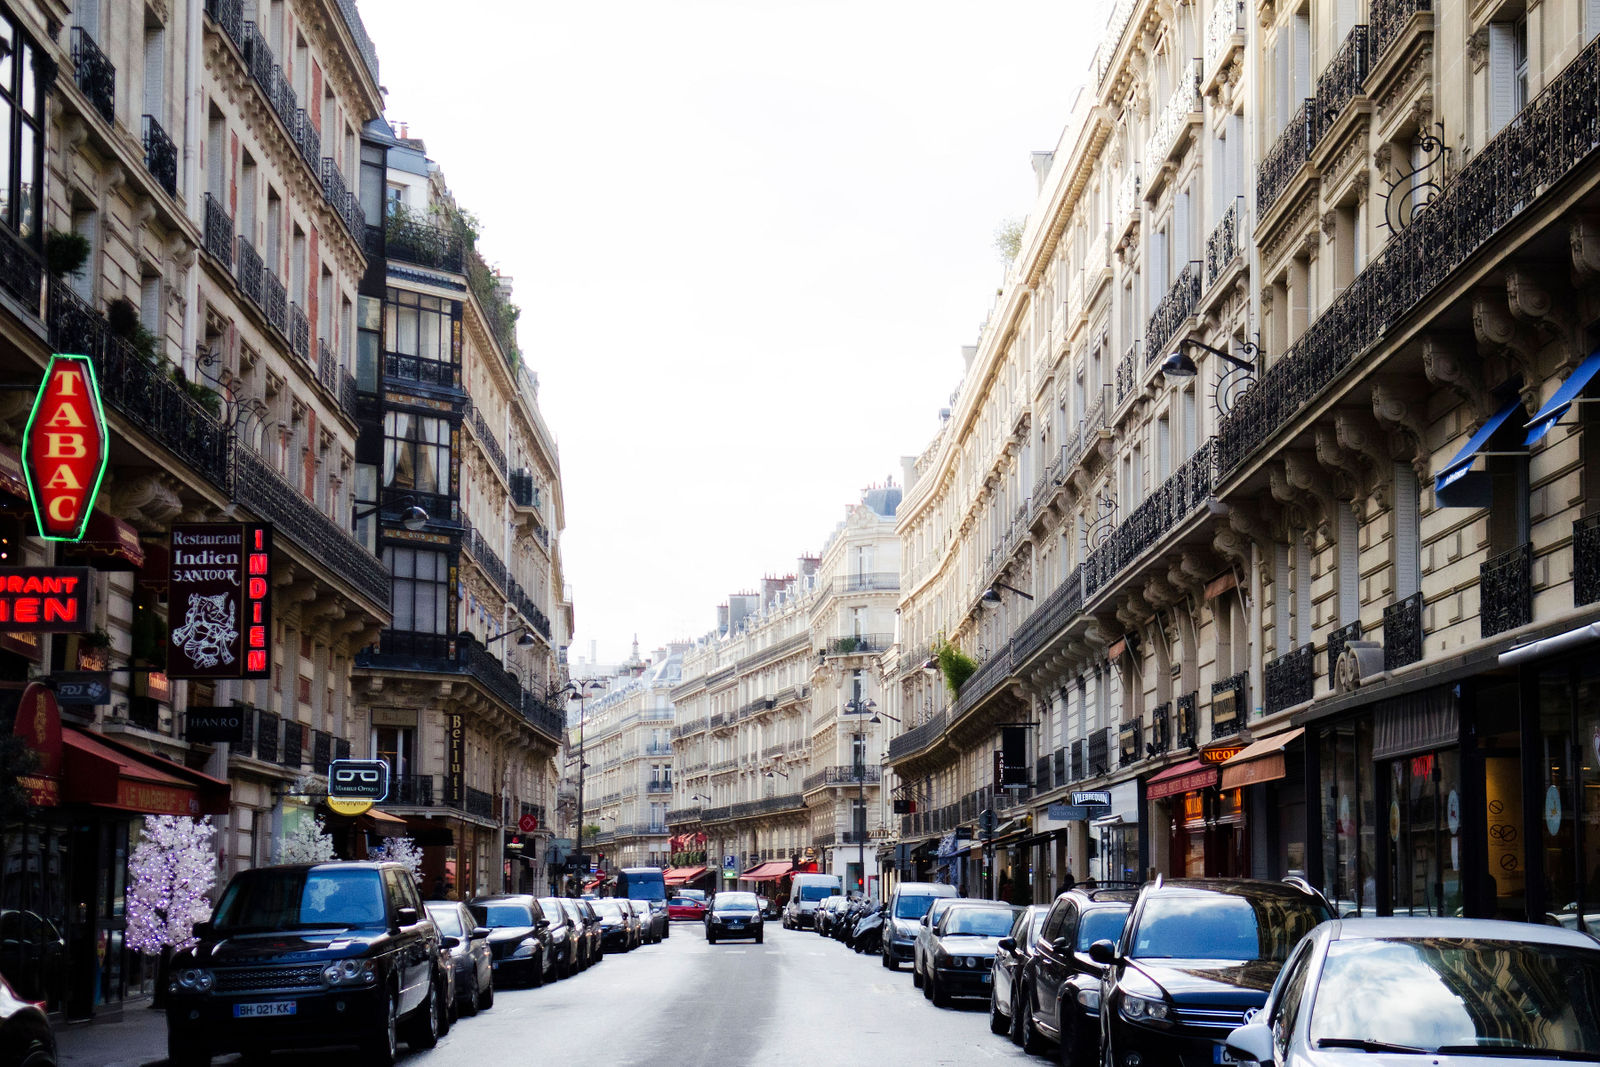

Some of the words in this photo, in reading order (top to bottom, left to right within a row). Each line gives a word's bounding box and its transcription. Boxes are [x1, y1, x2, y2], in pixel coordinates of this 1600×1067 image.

[43, 370, 87, 522] TABAC
[172, 530, 241, 545] Restaurant
[174, 549, 239, 565] Indien
[248, 529, 268, 671] INDIEN
[60, 684, 82, 695] FDJ
[190, 717, 240, 728] HANRO
[451, 715, 462, 800] Berluti
[1203, 749, 1241, 761] NICOL
[1073, 792, 1109, 805] VILEBREQUIN
[240, 1003, 290, 1015] BH-021-KK
